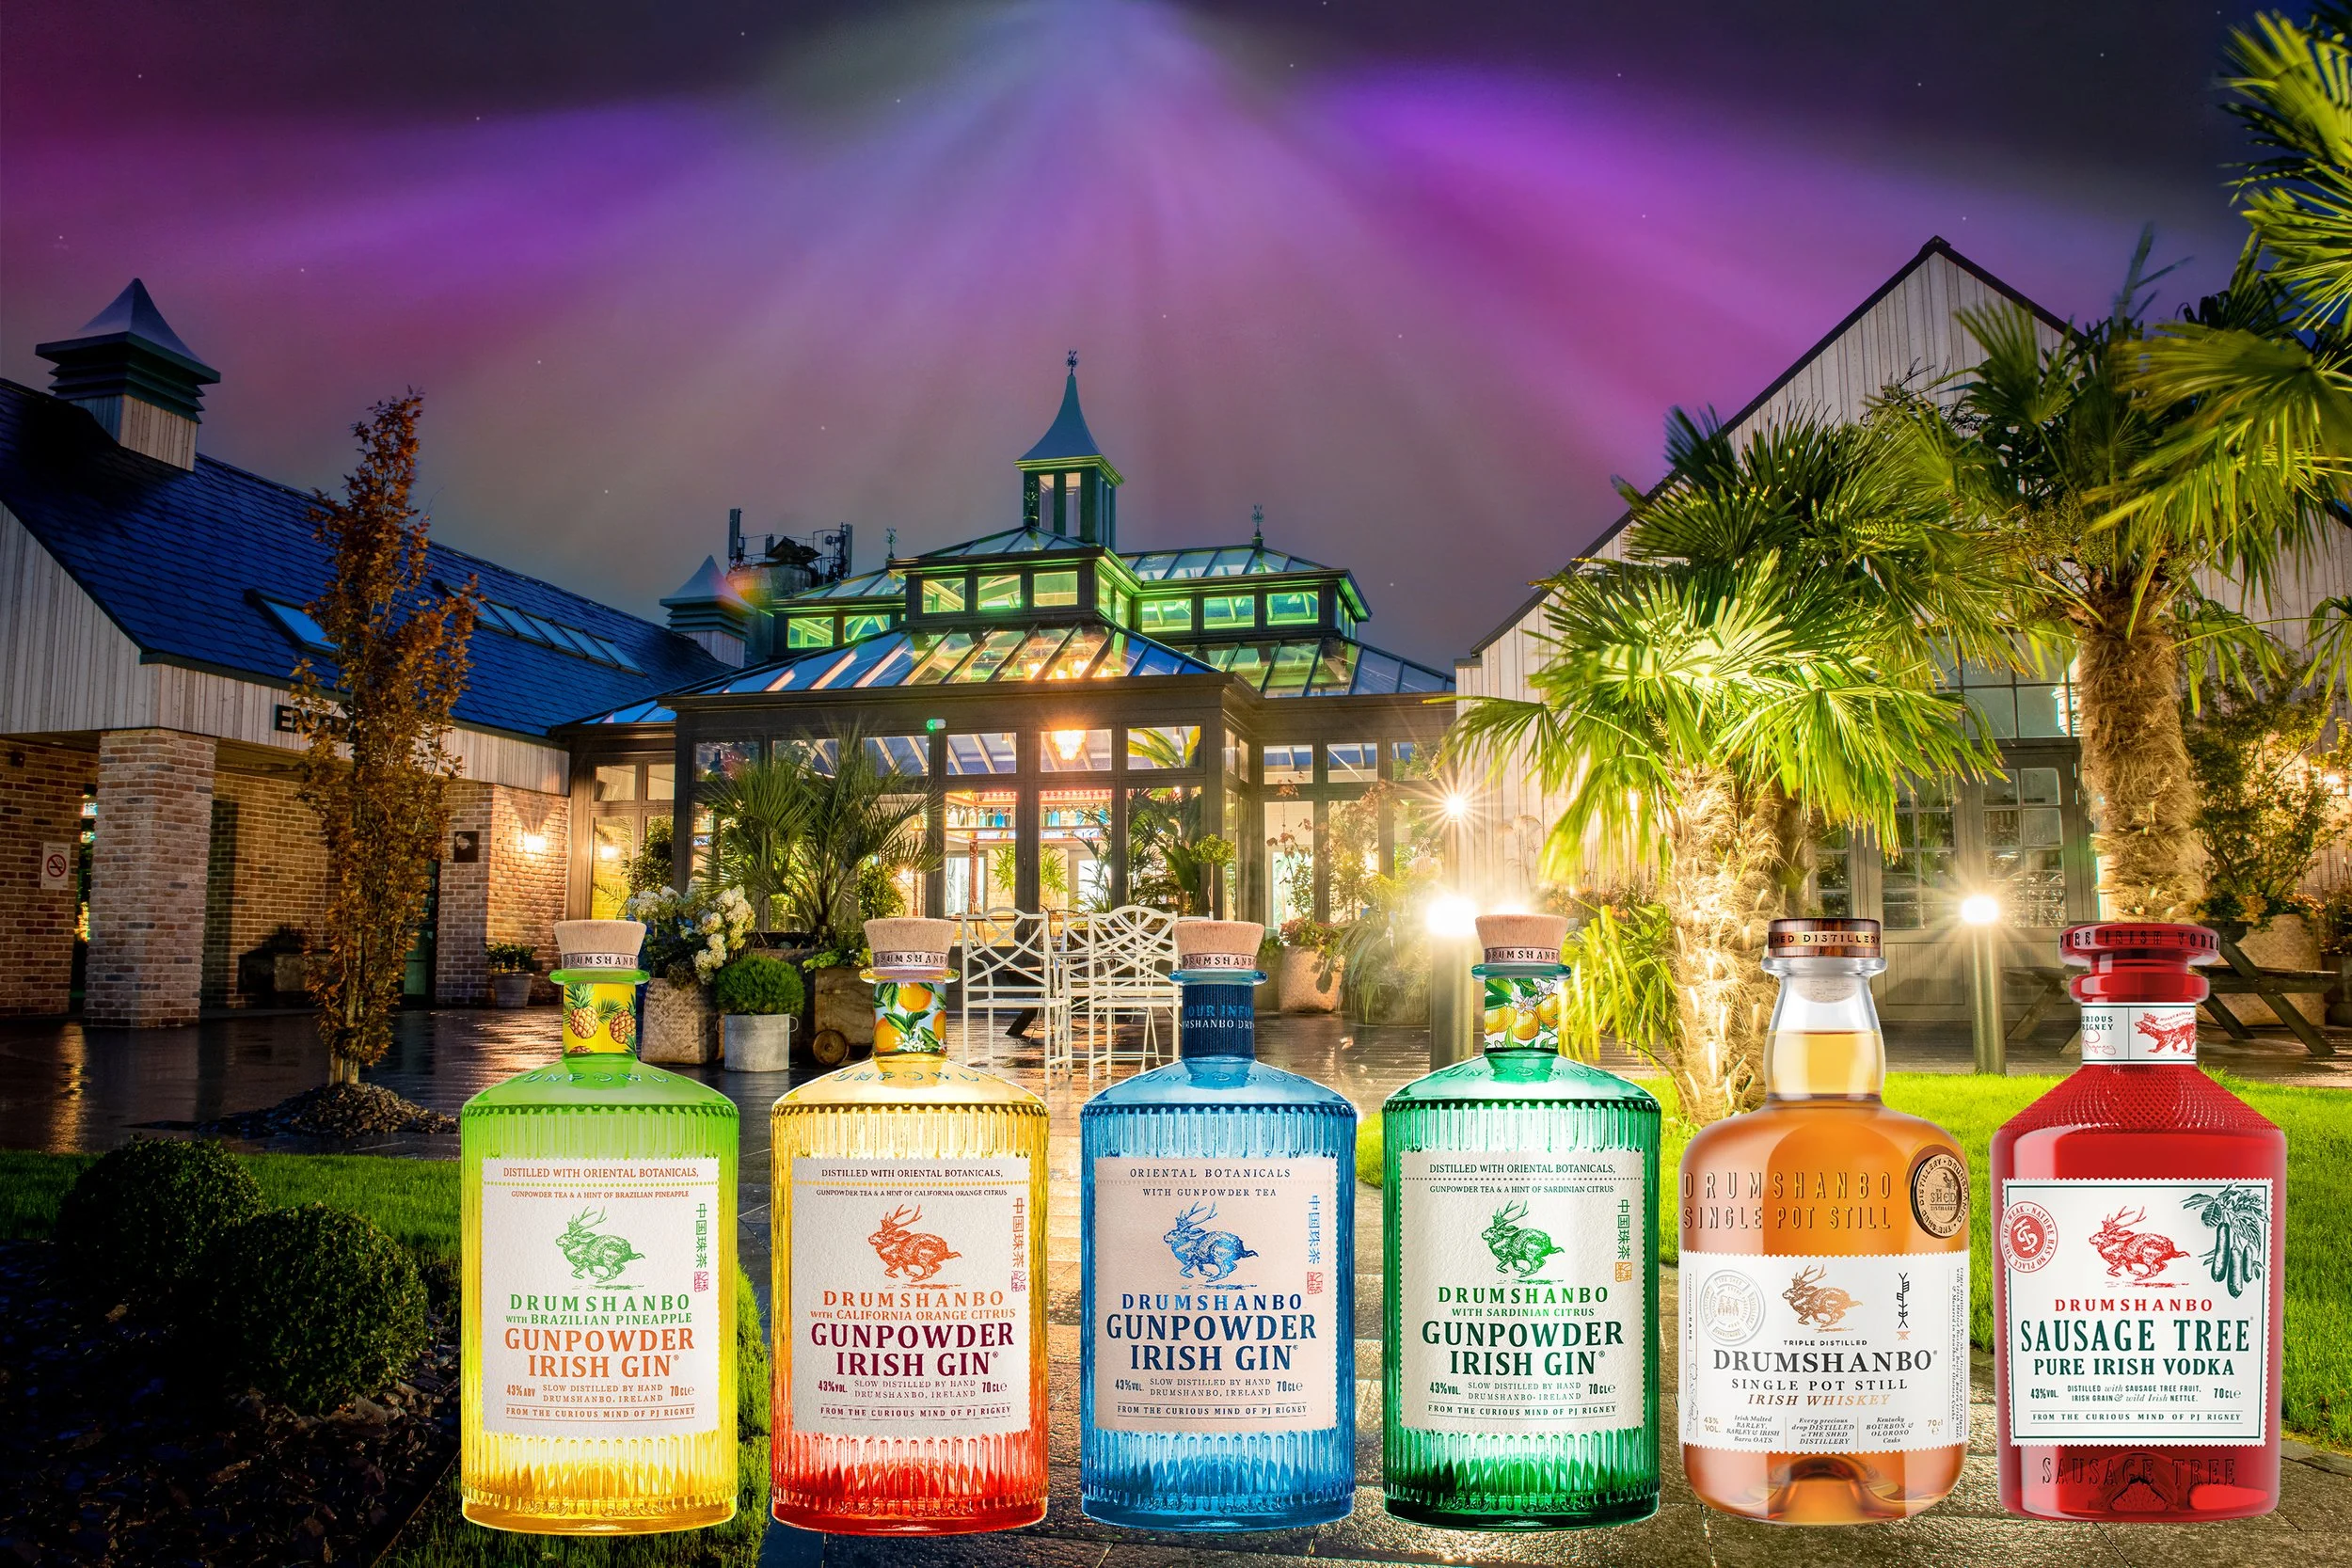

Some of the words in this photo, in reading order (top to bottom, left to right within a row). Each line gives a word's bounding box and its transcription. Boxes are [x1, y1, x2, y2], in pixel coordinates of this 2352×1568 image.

[1804, 934, 1881, 943] DISTILLERY
[503, 1168, 549, 1177] DISTILLED
[553, 1169, 580, 1178] WITH
[583, 1169, 636, 1178] ORIENTAL
[640, 1168, 698, 1178] BOTANICALS,
[1430, 1164, 1477, 1173] DISTILLED
[1480, 1164, 1503, 1173] WITH
[1507, 1164, 1553, 1173] ORIENTAL
[1556, 1164, 1615, 1173] BOTANICALS,
[1684, 1172, 1891, 1199] DRUMSHANBO
[1684, 1206, 1762, 1228] SINGLE
[1777, 1206, 1814, 1228] POT
[1830, 1206, 1891, 1228] STILL
[511, 1294, 691, 1311] DRUMSHANBO
[824, 1291, 1003, 1307] DRUMSHANBO
[1122, 1294, 1301, 1310] DRUMSHANBO
[1438, 1288, 1608, 1304] DRUMSHANBO
[2056, 1299, 2212, 1311] DRUMSHANBO
[532, 1315, 609, 1324] BRAZILIAN
[616, 1313, 691, 1324] PINEAPPLE
[836, 1310, 912, 1320] CALIFORNIA
[916, 1311, 966, 1320] ORANGE
[971, 1309, 1015, 1319] CITRUS
[811, 1323, 1014, 1348] GUNPOWDER
[1106, 1315, 1316, 1340] GUNPOWDER
[1422, 1322, 1624, 1347] GUNPOWDER
[2021, 1320, 2154, 1351] SAUSAGE
[505, 1328, 693, 1352] GUNPOWDER
[529, 1355, 609, 1377] IRISH
[836, 1353, 924, 1376] IRISH
[1131, 1345, 1221, 1370] IRISH
[1451, 1351, 1532, 1375] IRISH
[2034, 1359, 2084, 1375] PURE
[2094, 1358, 2154, 1374] IRISH
[2163, 1358, 2234, 1375] VODKA
[1732, 1379, 1798, 1390] SINGLE
[1809, 1381, 1844, 1390] POT
[1855, 1380, 1907, 1390] STILL
[1749, 1395, 1799, 1405] IRISH
[1807, 1396, 1889, 1405] WHISKEY
[506, 1407, 529, 1416] FROM
[554, 1409, 598, 1418] CURIOUS
[650, 1409, 660, 1418] PJ
[663, 1407, 695, 1416] RIGNEY
[1457, 1406, 1476, 1415] THE
[1479, 1407, 1520, 1416] CURIOUS
[1552, 1407, 1565, 1416] OF
[1568, 1407, 1578, 1416] PJ
[1581, 1405, 1616, 1414] RIGNEY
[2042, 1457, 2153, 1486] SAUSAGE
[2172, 1457, 2235, 1486] TREE
